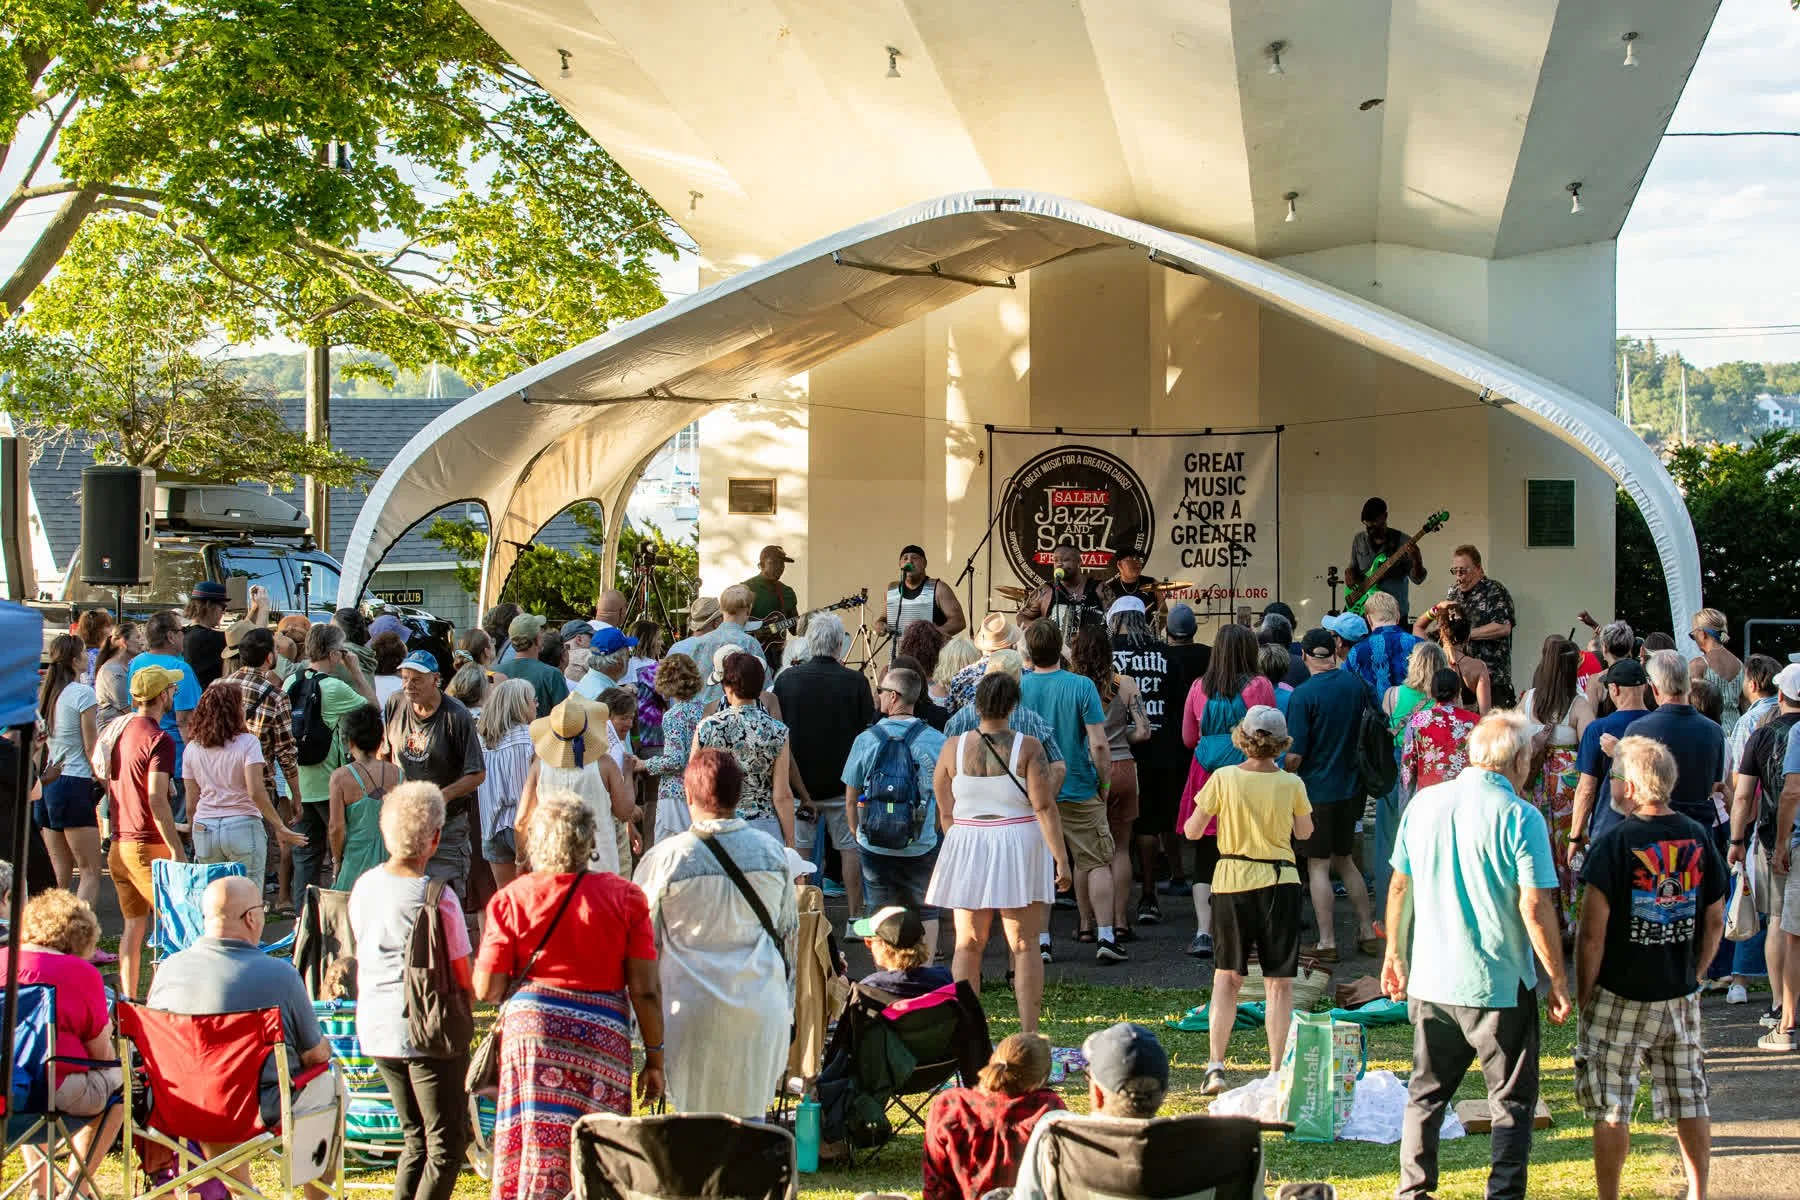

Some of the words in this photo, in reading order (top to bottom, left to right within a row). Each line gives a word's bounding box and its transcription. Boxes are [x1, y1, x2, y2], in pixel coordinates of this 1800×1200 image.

[1022, 467, 1042, 488] GREAT
[1040, 457, 1062, 473] MUSIC
[1061, 455, 1076, 465] FOR
[1076, 455, 1082, 465] A
[1082, 455, 1113, 474] GREATER
[1184, 452, 1245, 473] GREAT
[1184, 476, 1246, 497] MUSIC
[1034, 488, 1106, 525] Jazz
[1055, 491, 1106, 504] SALEM
[1186, 500, 1225, 521] FOR
[1230, 500, 1242, 519] A
[1036, 516, 1117, 553] Soul
[1064, 524, 1092, 534] AND
[1171, 523, 1257, 545] GREATER
[1039, 552, 1108, 565] FEVAL
[1181, 547, 1248, 569] CAUSE!
[1020, 561, 1036, 579] MUSIC
[375, 592, 395, 603] CHT
[396, 592, 421, 603] CLUB
[1112, 650, 1168, 674] Faith
[1300, 1045, 1320, 1122] Marshalls
